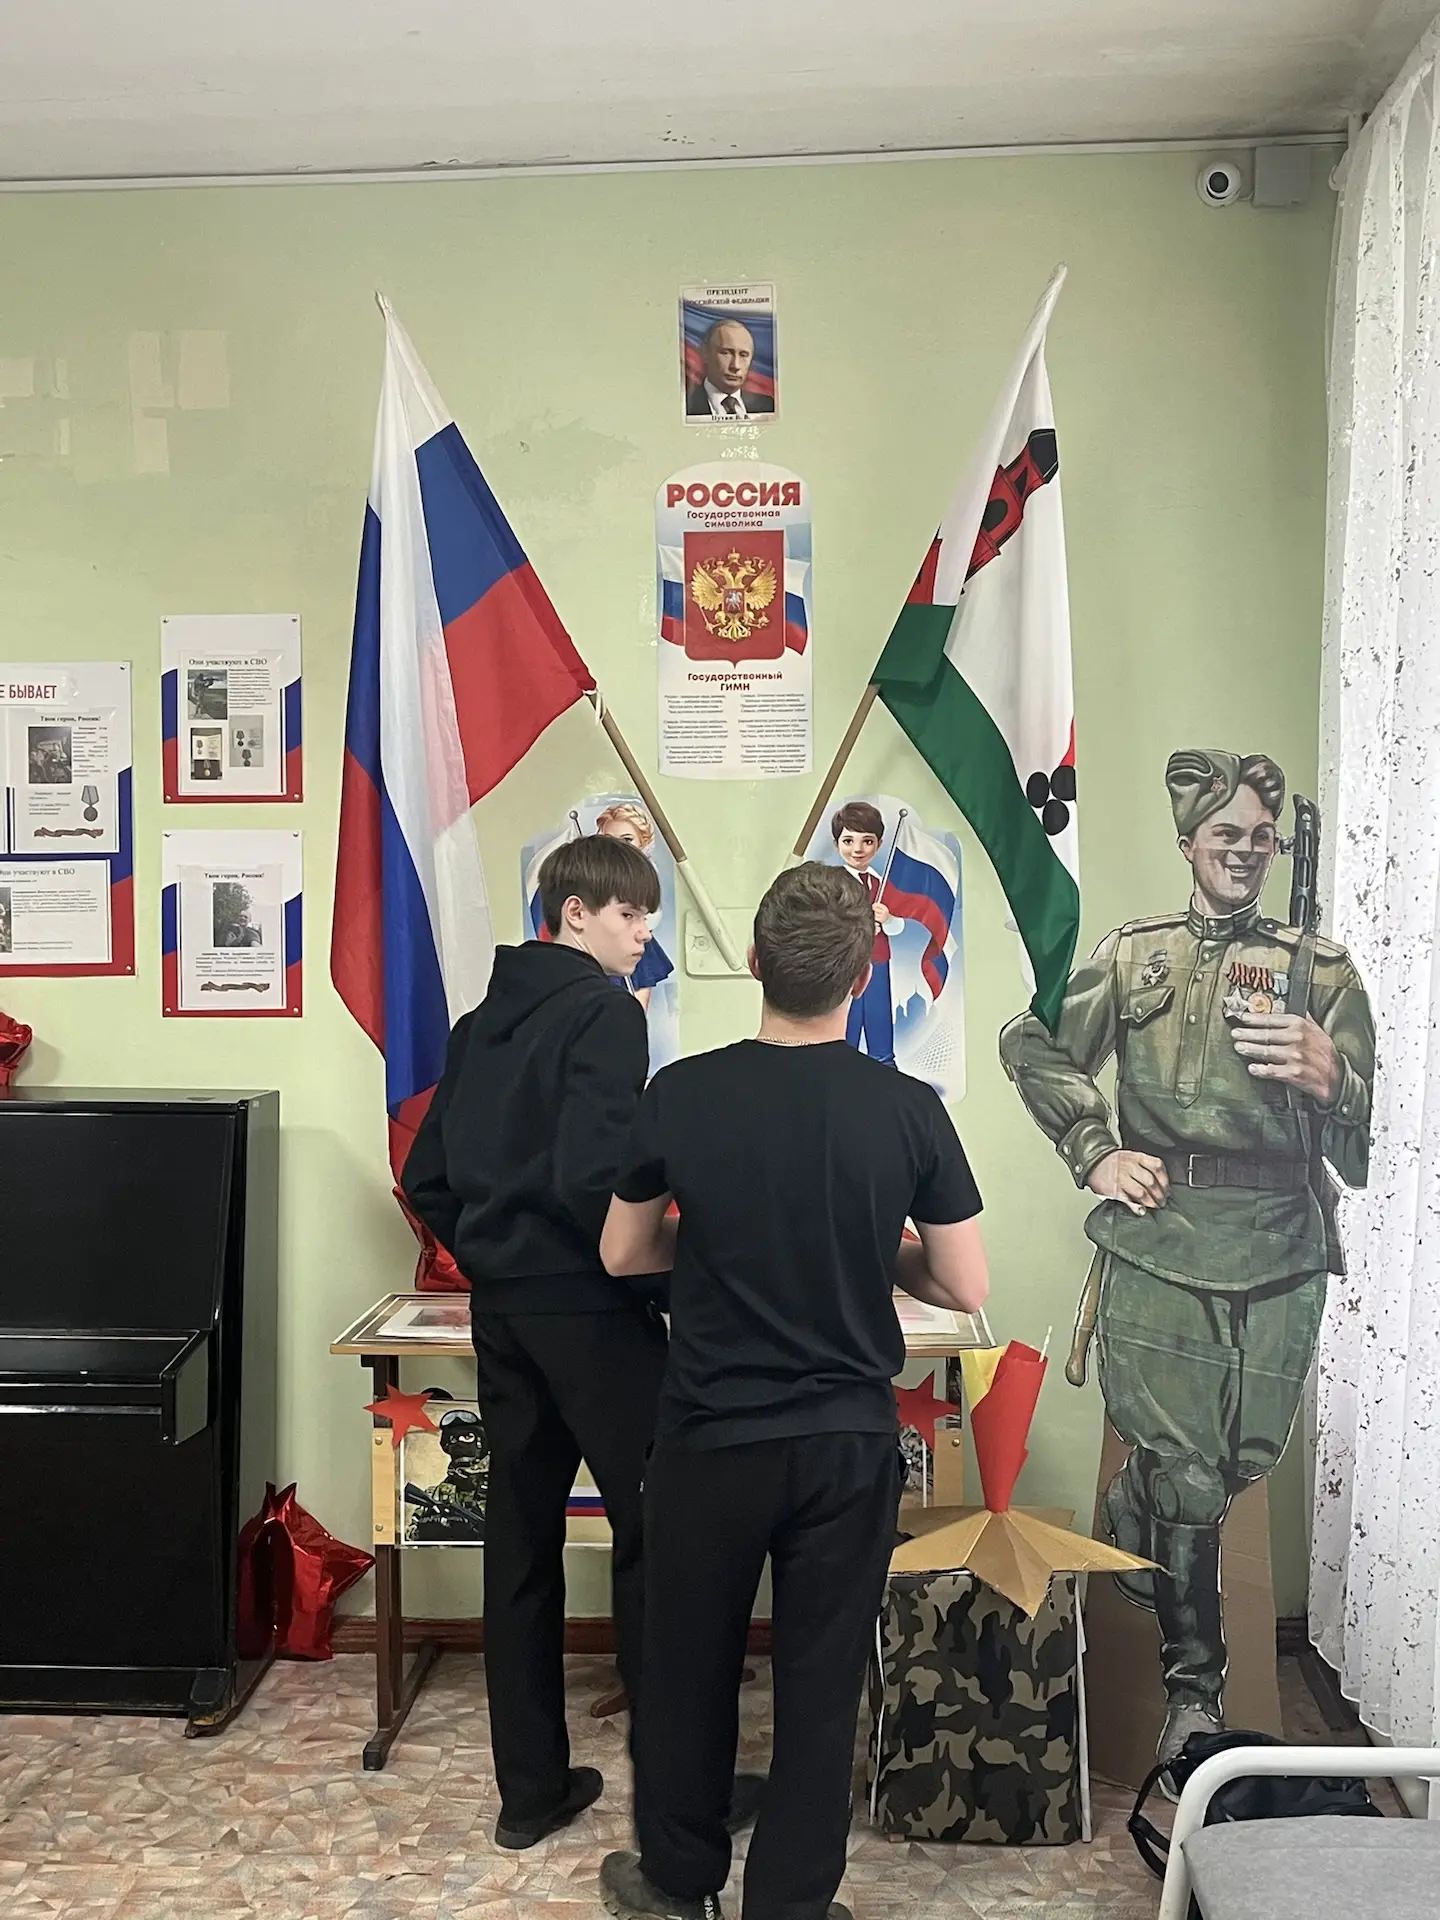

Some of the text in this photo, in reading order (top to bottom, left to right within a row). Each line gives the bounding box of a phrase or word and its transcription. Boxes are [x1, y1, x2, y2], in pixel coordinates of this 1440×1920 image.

[666, 482, 801, 507] РОССИЯ
[687, 510, 781, 520] Государственная
[704, 519, 763, 528] символика
[249, 657, 268, 665] СВО
[688, 671, 783, 682] Государственный
[9, 684, 57, 699] БЫВАЕТ
[57, 867, 76, 875] СВО
